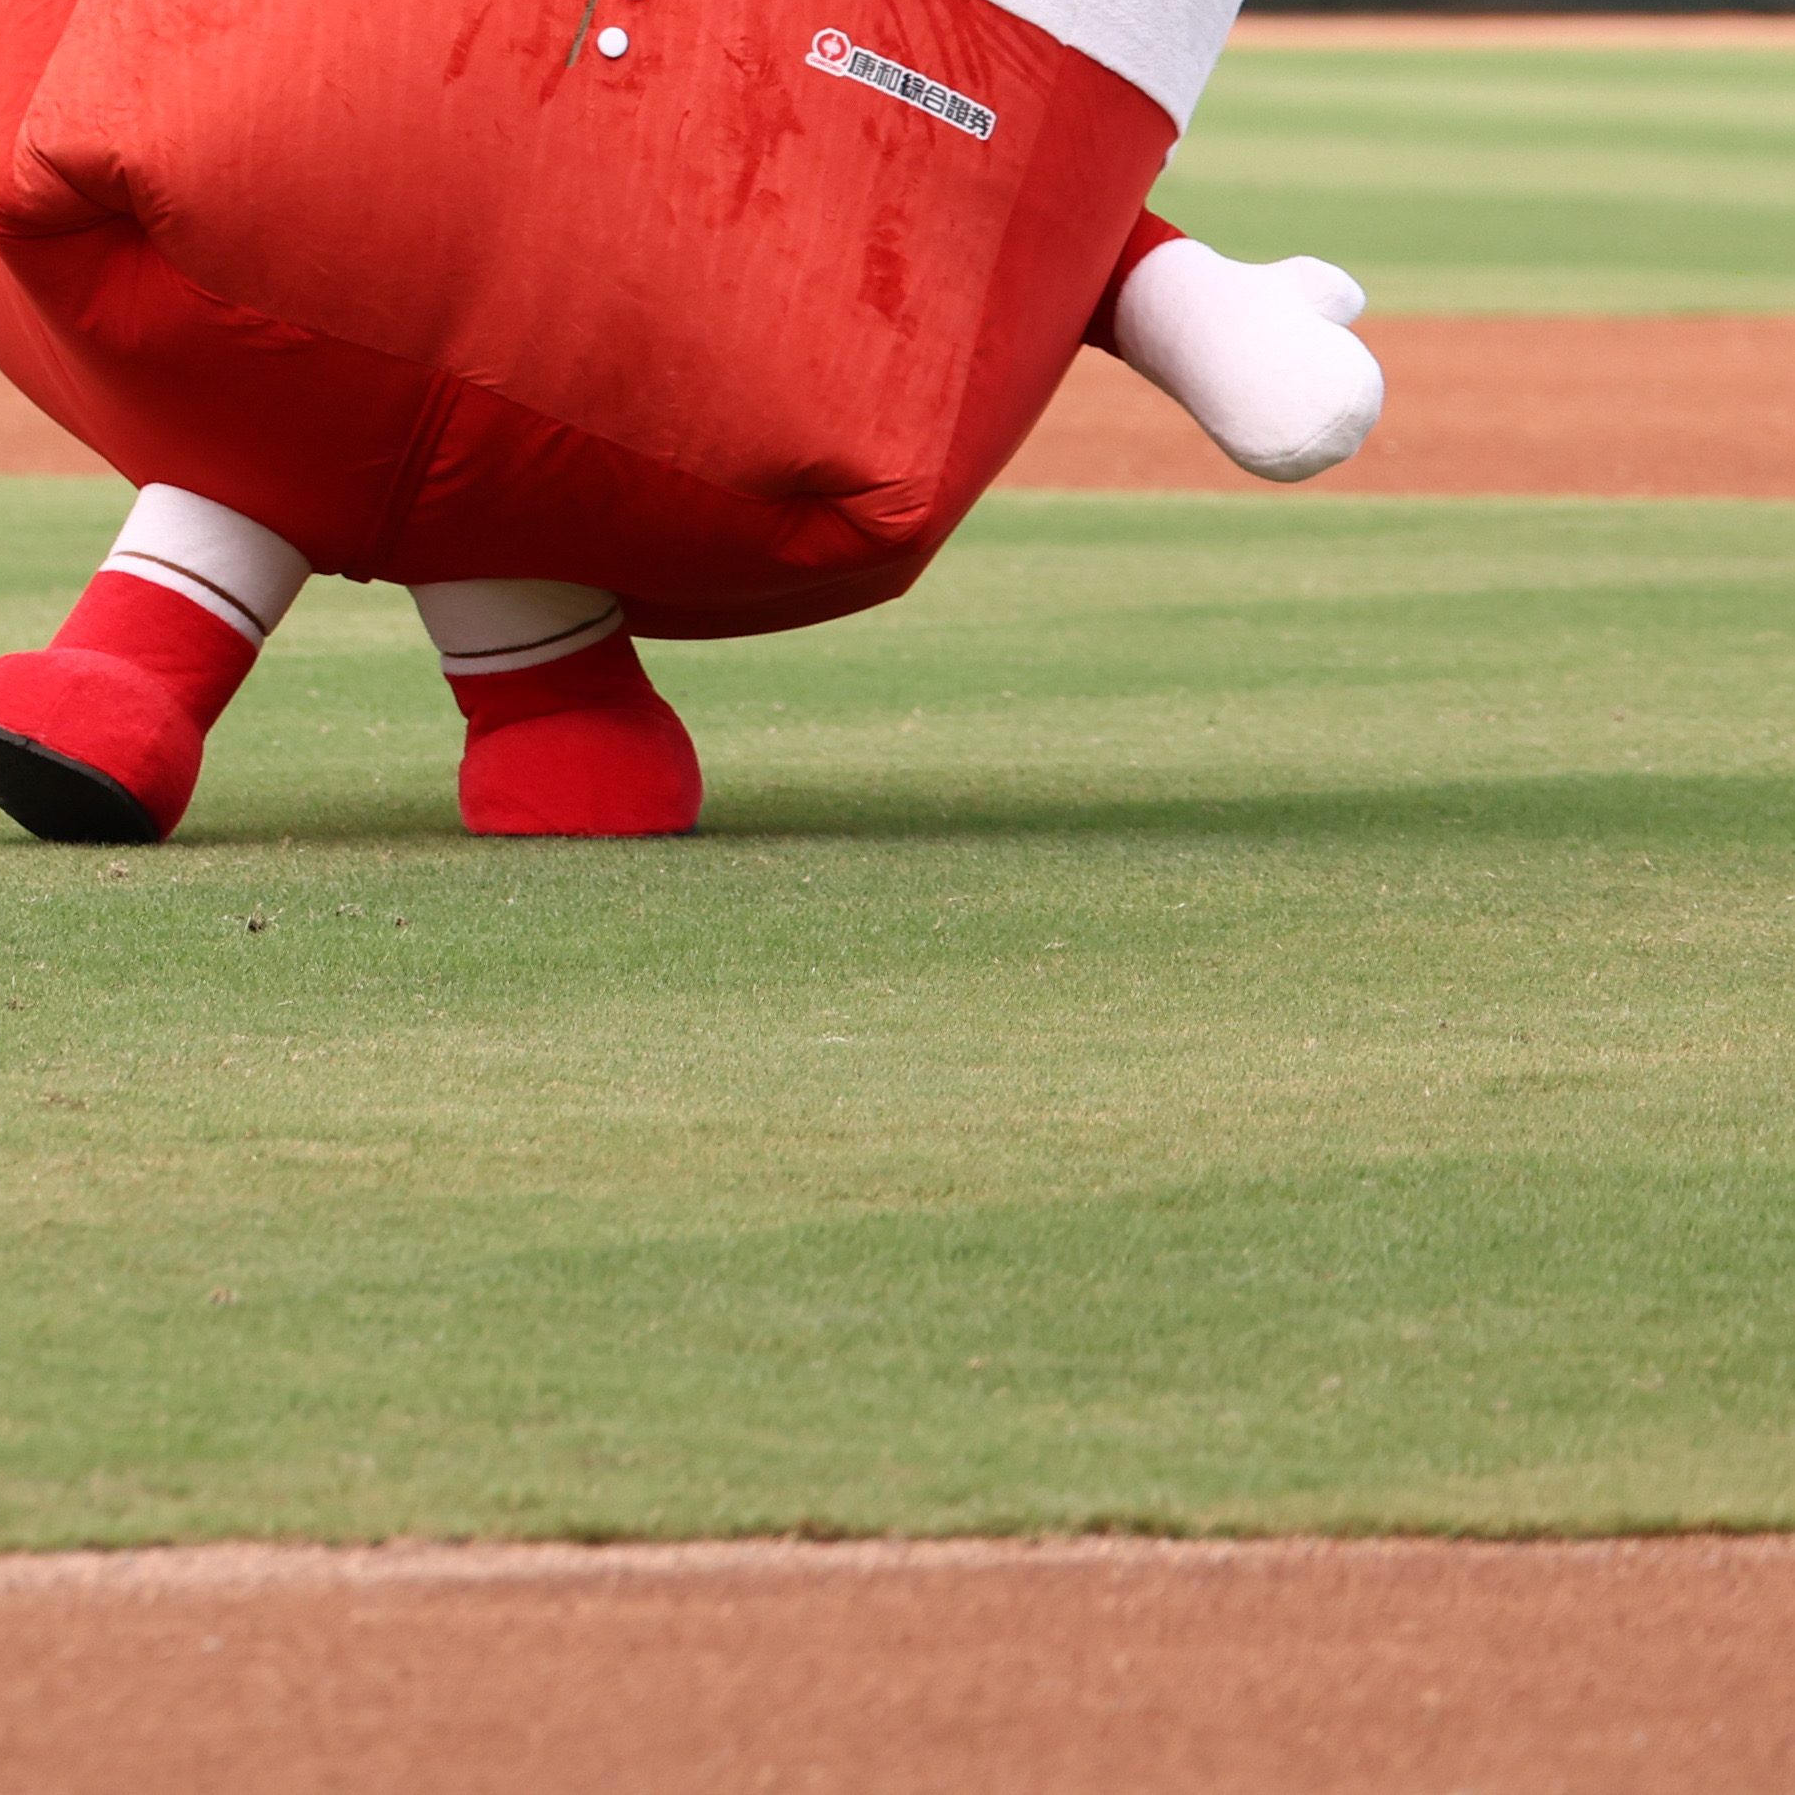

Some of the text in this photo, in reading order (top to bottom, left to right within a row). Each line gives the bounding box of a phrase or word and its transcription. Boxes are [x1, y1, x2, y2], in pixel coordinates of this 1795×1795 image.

[847, 50, 994, 137] 康和綜合證券
